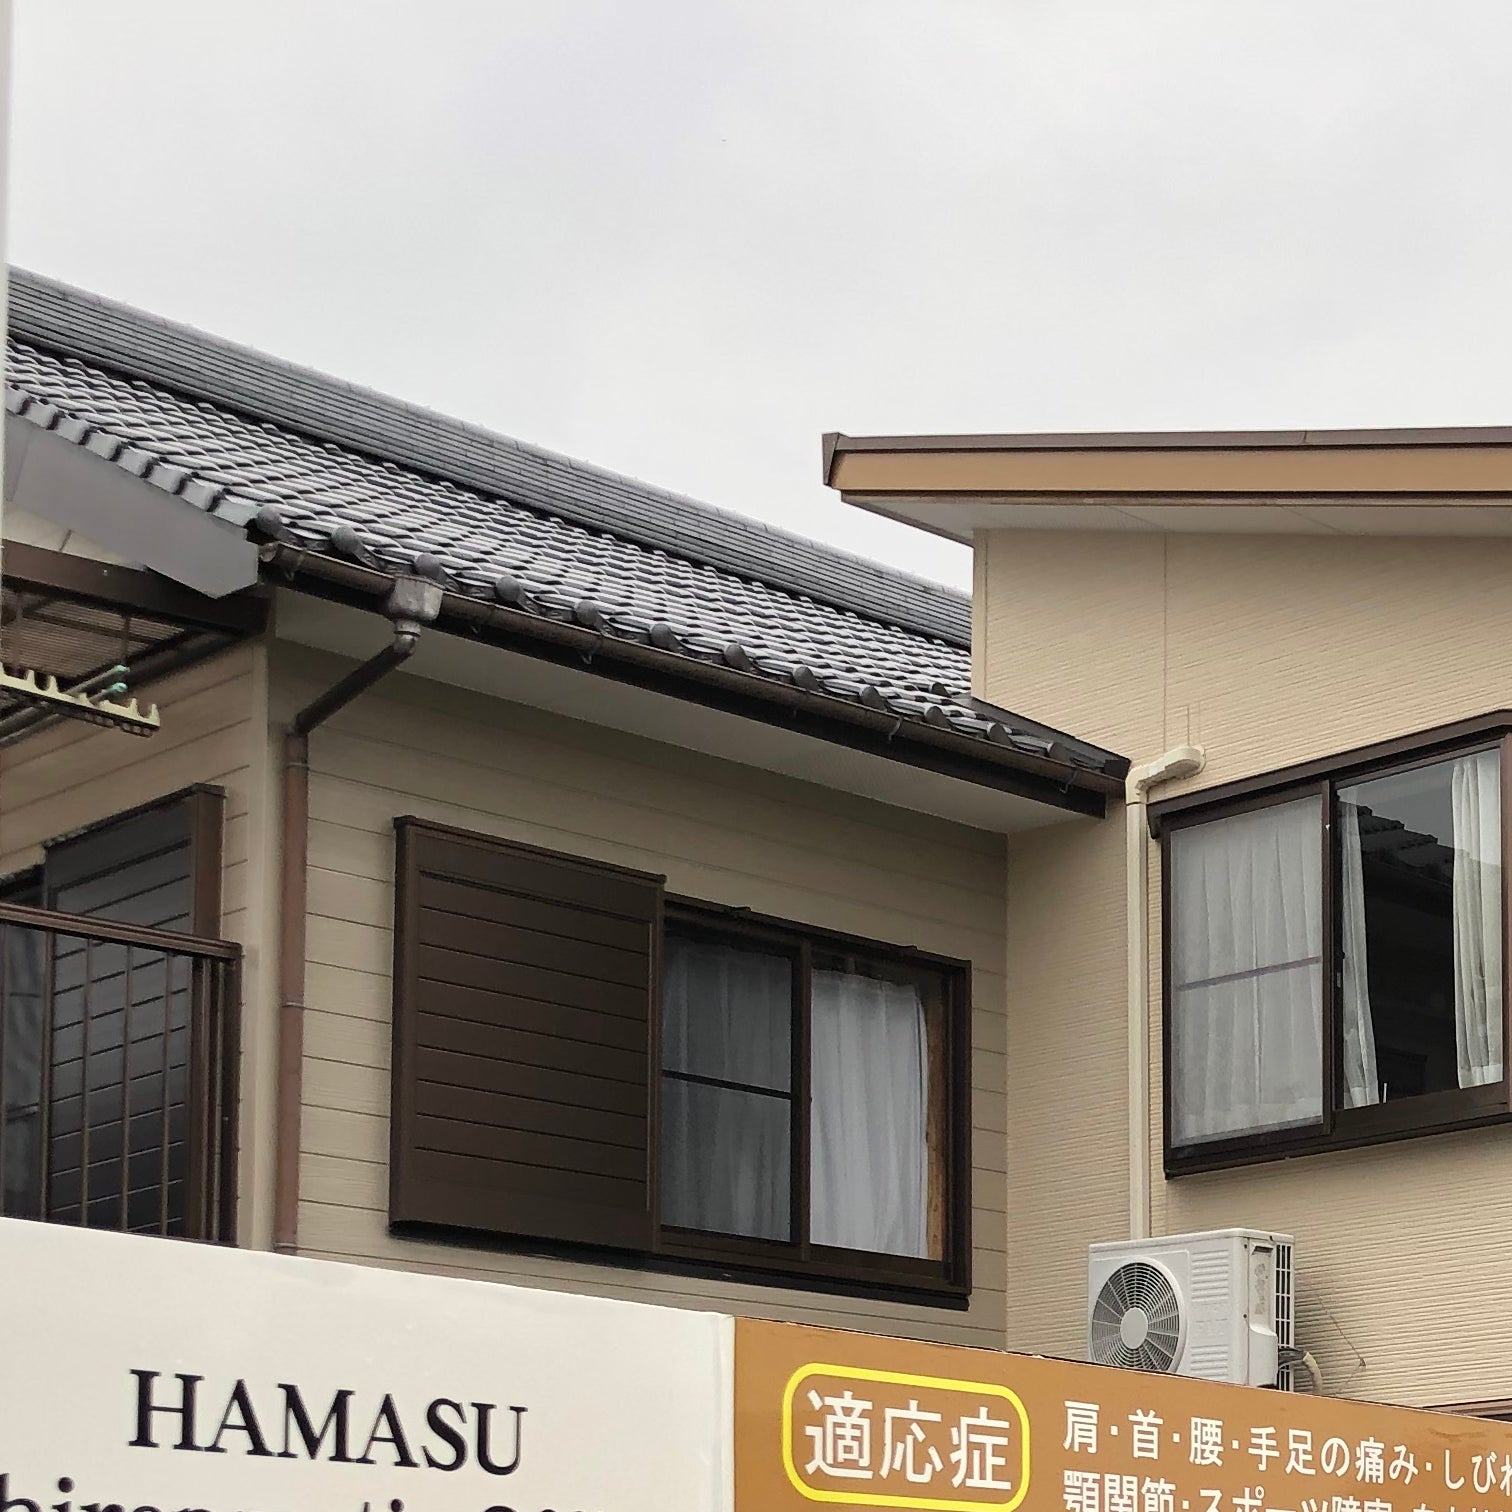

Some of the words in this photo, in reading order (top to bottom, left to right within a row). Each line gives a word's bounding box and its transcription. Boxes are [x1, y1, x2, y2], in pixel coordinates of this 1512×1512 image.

[128, 1368, 528, 1476] HAMASU
[804, 1389, 1012, 1491] 適応症
